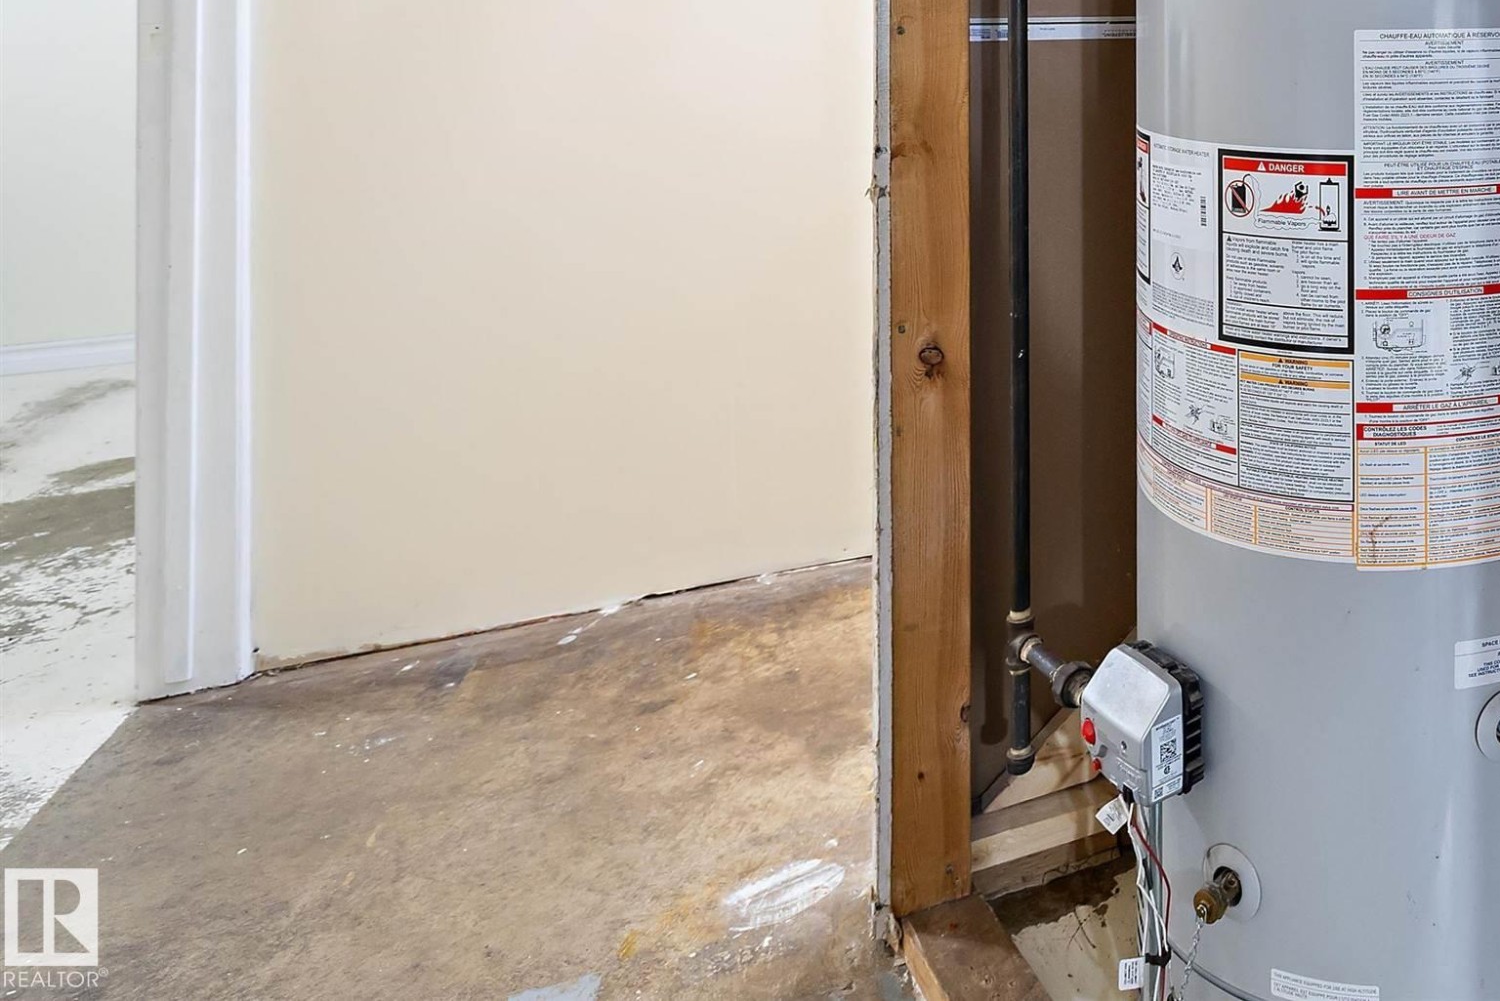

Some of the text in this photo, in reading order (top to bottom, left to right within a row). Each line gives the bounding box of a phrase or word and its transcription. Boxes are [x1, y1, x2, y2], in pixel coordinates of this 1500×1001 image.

[1379, 32, 1423, 40] CHAUFFE-EAU
[1423, 31, 1465, 40] AUTOMATIQUE
[1268, 163, 1305, 173] DANGER
[1257, 218, 1307, 227] Flammable Vapors
[1408, 287, 1483, 297] CONSIGNES D'UTILISATION
[1481, 639, 1498, 647] SPACE
